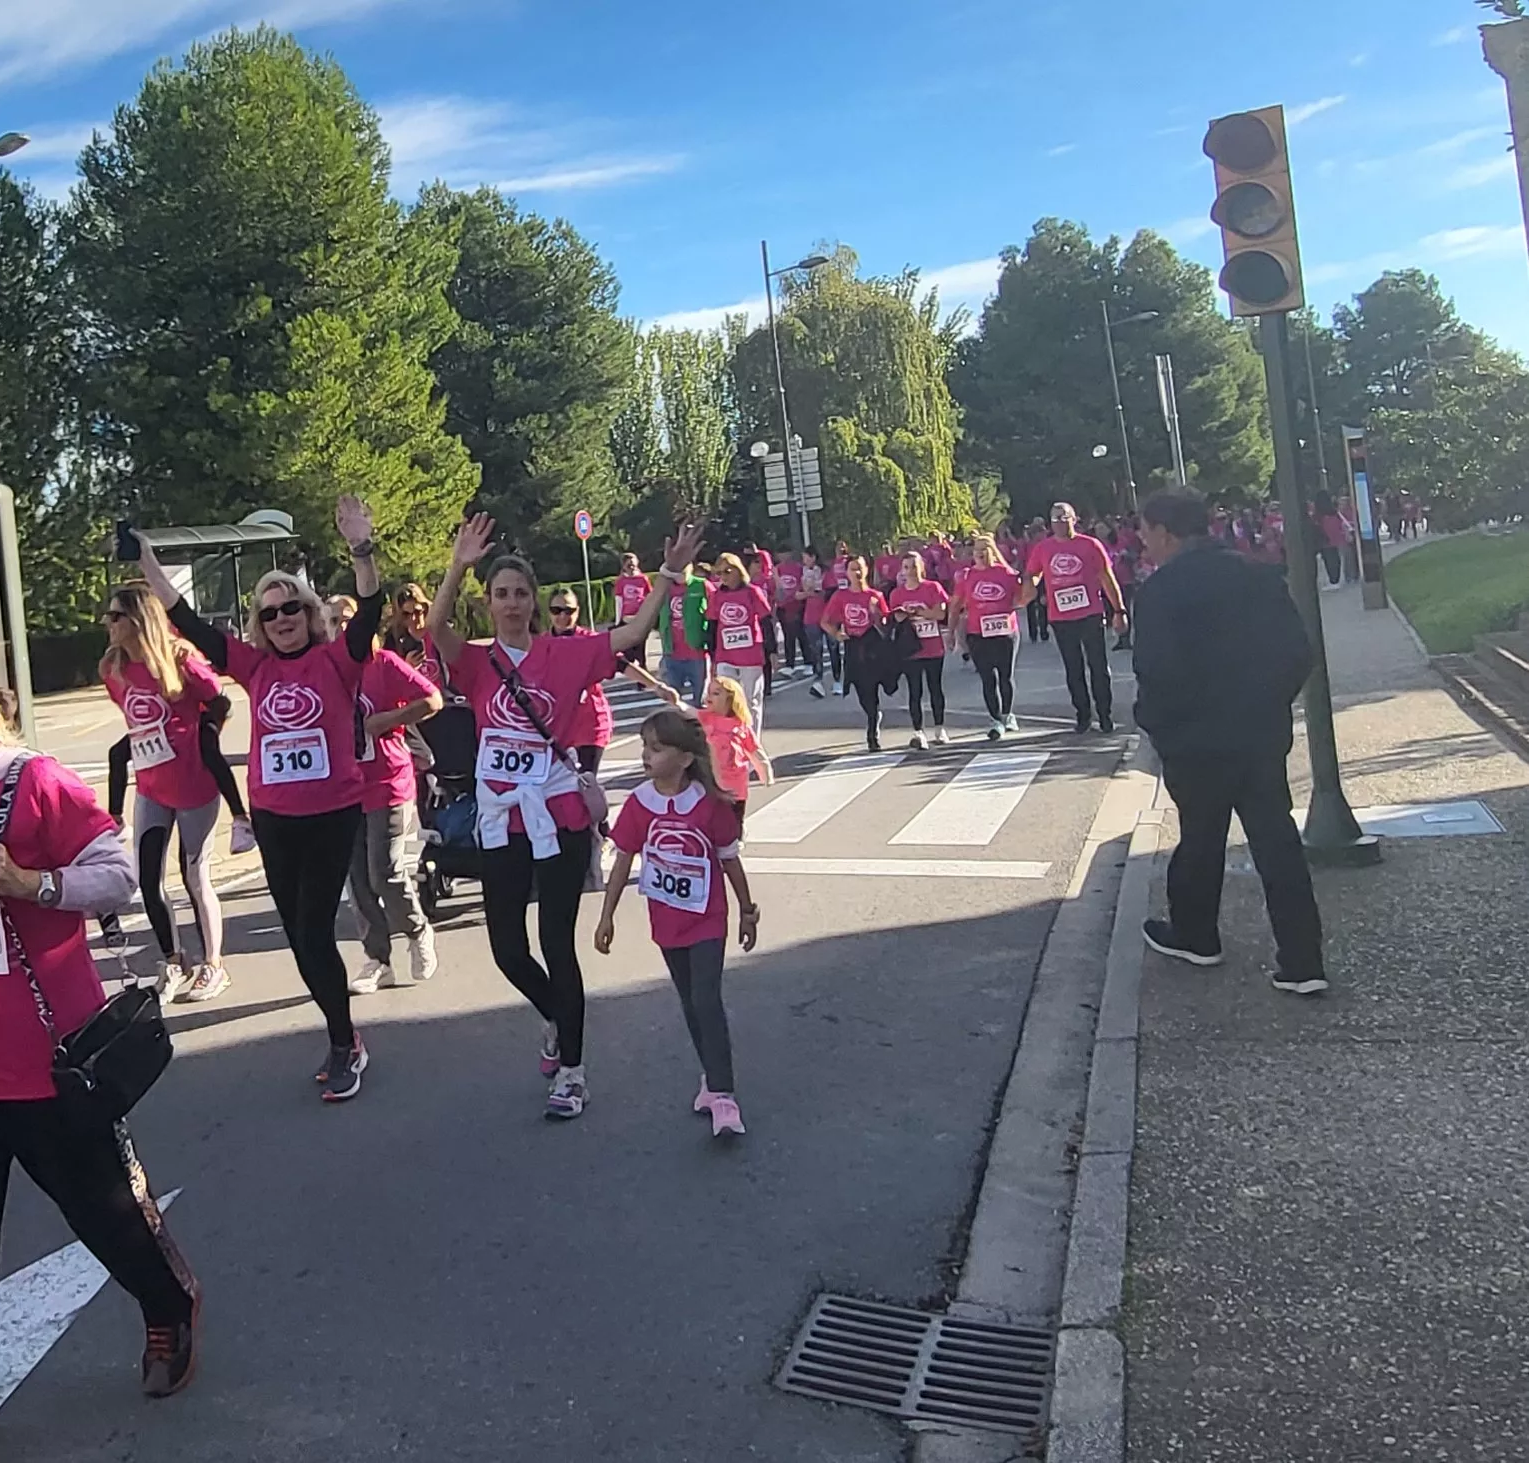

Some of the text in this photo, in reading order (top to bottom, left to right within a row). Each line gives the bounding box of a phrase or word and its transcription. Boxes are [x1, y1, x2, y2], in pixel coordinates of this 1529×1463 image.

[272, 749, 313, 773] 310
[490, 749, 534, 774] 309
[651, 867, 692, 899] 308
